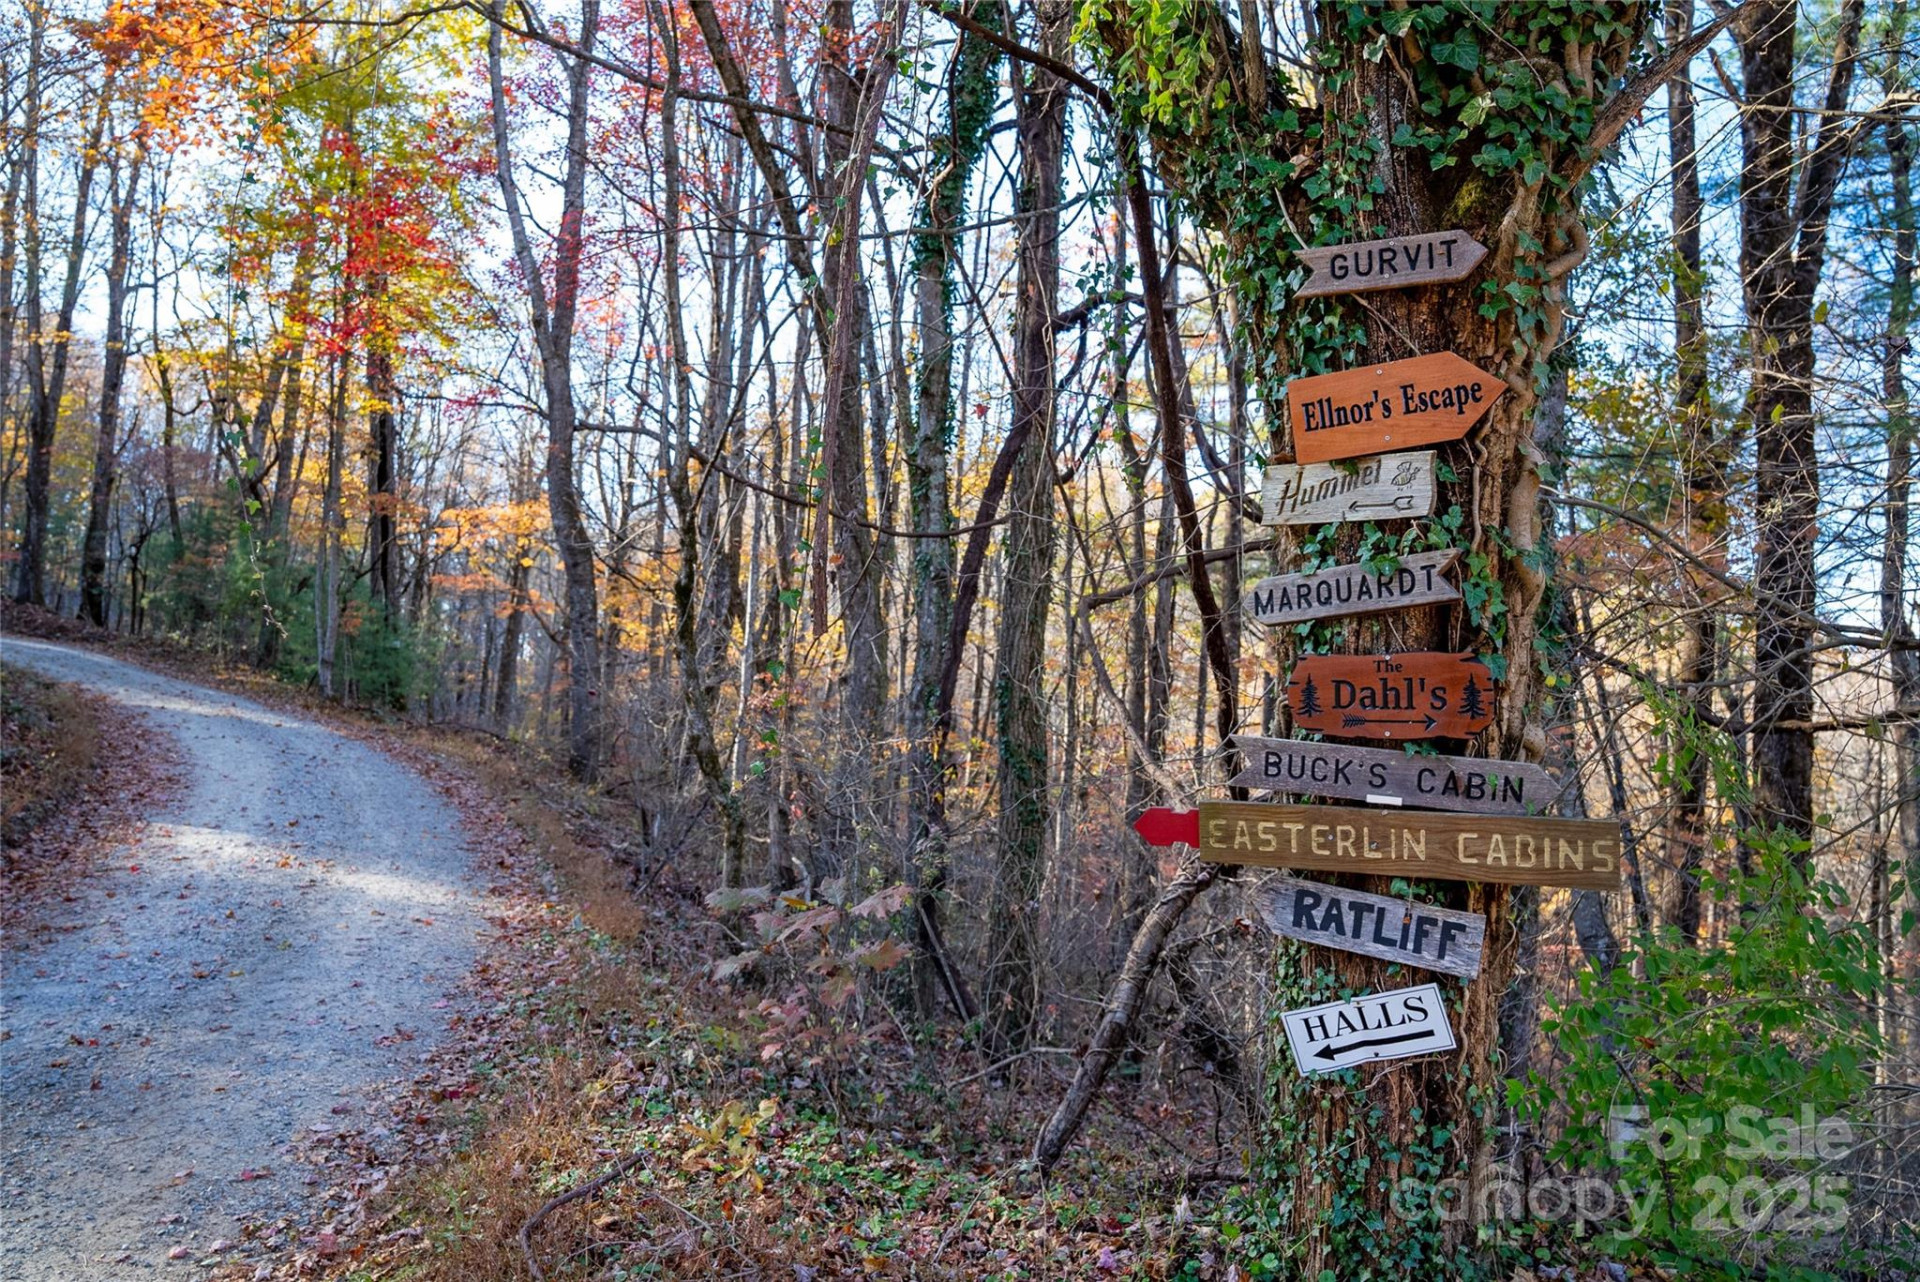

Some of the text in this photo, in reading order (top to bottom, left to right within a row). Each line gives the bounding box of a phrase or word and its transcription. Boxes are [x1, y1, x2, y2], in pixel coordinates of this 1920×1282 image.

[1330, 239, 1458, 280] GURVIT
[1301, 381, 1483, 432] Ellnor's Escape
[1277, 458, 1382, 516] Hummel
[1253, 564, 1437, 617] MARQUARDT
[1374, 660, 1403, 673] The
[1331, 677, 1447, 711] Dahl's
[1264, 751, 1524, 803] BUCK'S CABIN
[1208, 819, 1614, 873] EASTERLIN CABINS
[1292, 889, 1467, 960] RATLIFF
[1302, 996, 1429, 1044] HALLS
